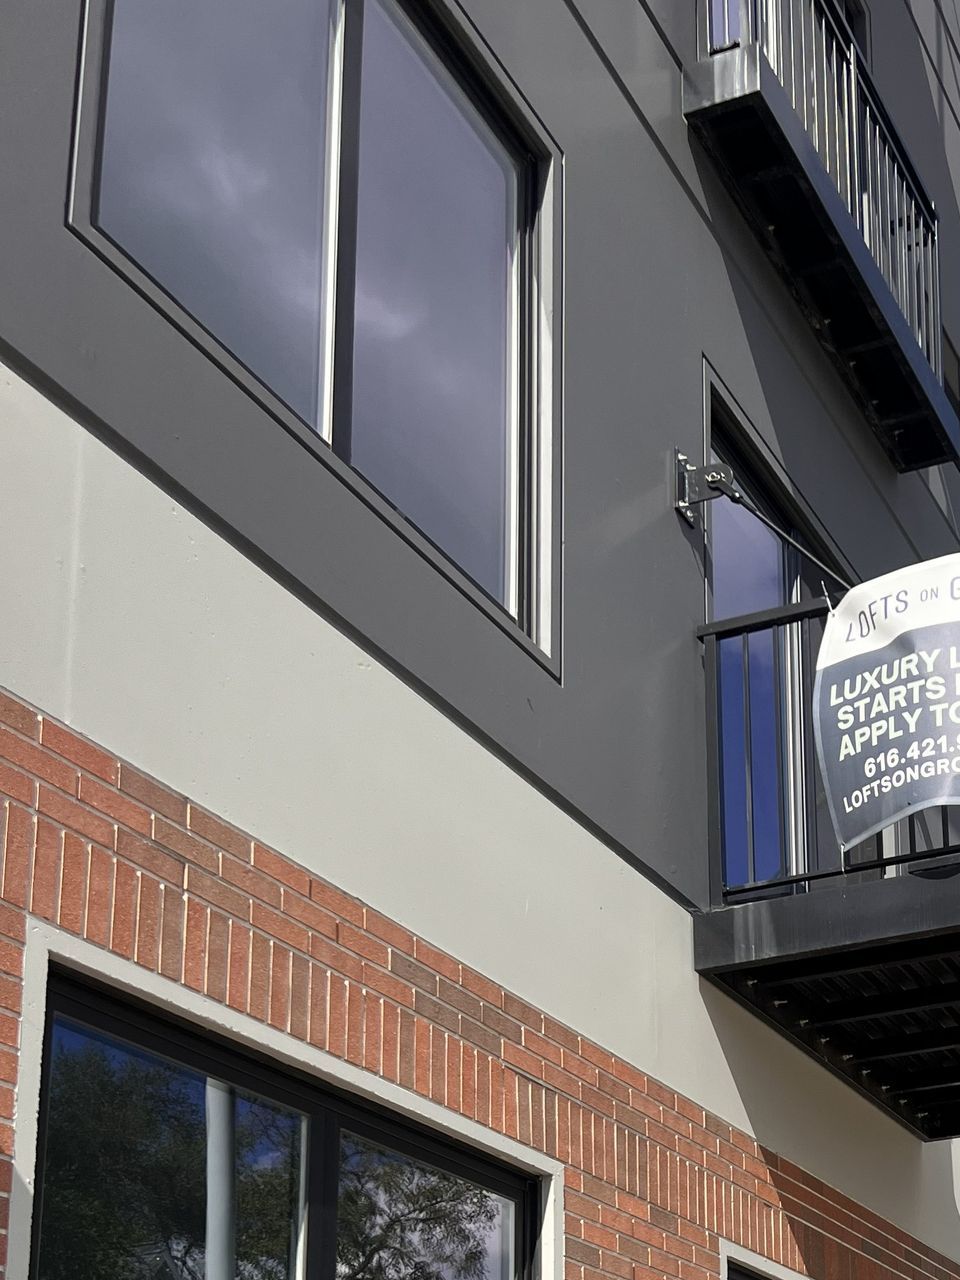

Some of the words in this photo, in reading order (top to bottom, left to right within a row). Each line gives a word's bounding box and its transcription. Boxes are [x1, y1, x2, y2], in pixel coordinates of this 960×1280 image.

[845, 589, 909, 643] LOFTS
[919, 587, 939, 602] ON
[829, 648, 942, 707] LUXURY
[837, 675, 946, 731] STARTS
[838, 708, 928, 762] APPLY
